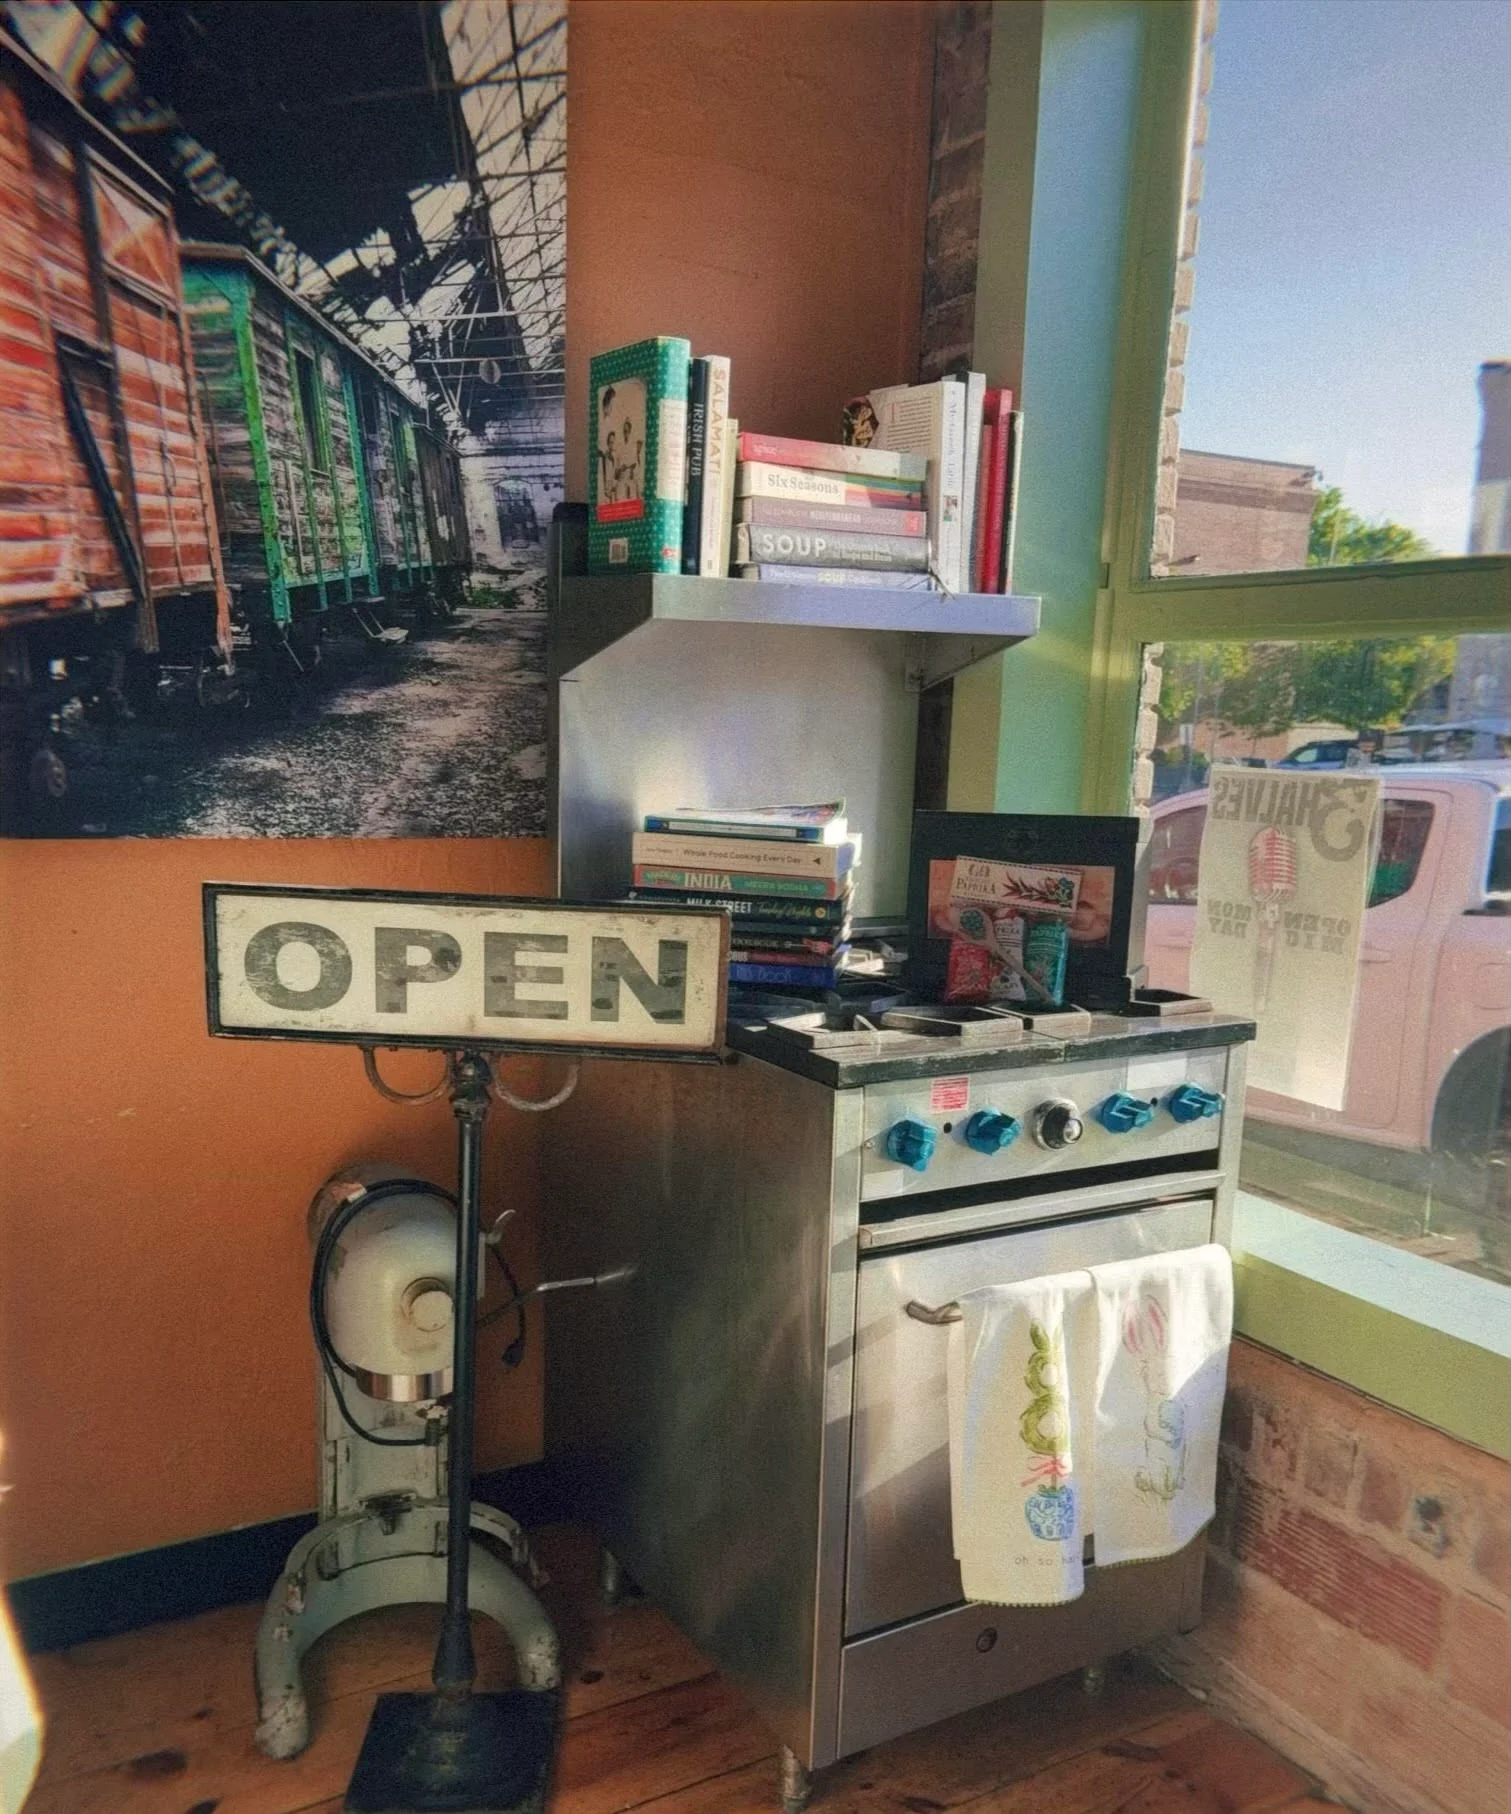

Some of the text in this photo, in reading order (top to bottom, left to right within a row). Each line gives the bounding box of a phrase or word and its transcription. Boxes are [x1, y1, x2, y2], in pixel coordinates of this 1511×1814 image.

[709, 368, 725, 475] SALAMATI
[691, 402, 704, 477] IRISH PUB
[767, 474, 840, 494] Six Seasons
[763, 534, 826, 558] SOUP
[683, 849, 707, 858] Whole
[709, 850, 728, 859] Food
[730, 851, 761, 863] Cooking
[763, 853, 785, 864] Every
[684, 872, 732, 890] INDIA
[244, 921, 688, 1024] OPEN
[1015, 1556, 1028, 1566] oh
[1039, 1558, 1052, 1566] so
